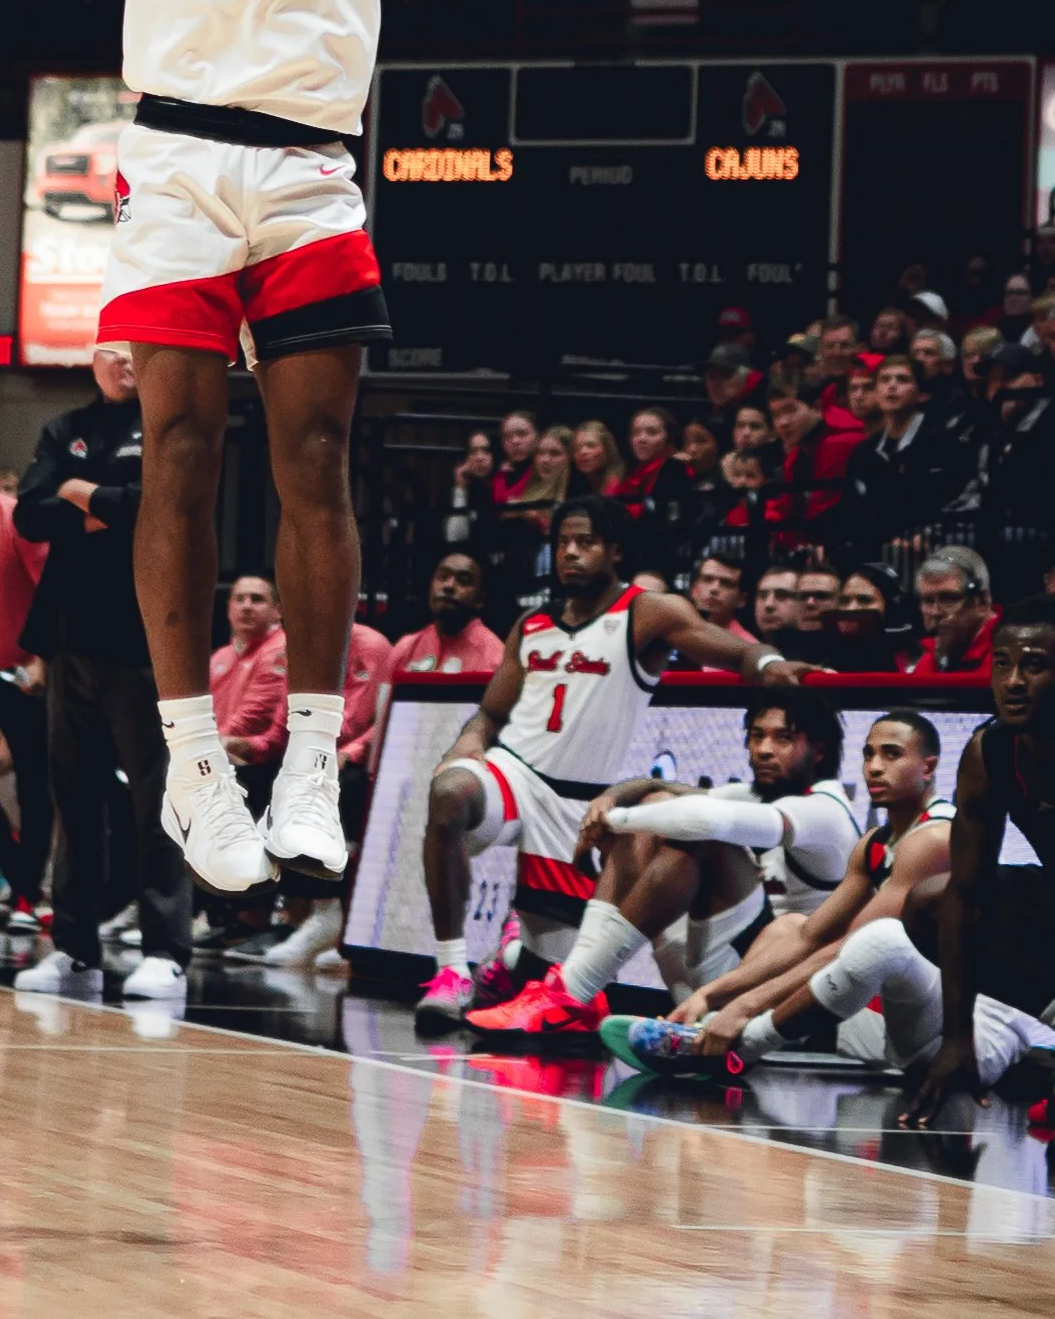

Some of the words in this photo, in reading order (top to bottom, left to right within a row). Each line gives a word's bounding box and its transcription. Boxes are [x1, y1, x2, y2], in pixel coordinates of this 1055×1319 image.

[382, 147, 514, 182] CARDINALS
[705, 145, 800, 181] CAJUNS
[539, 262, 606, 282] PLAYER
[613, 263, 656, 283] FOUL
[747, 263, 803, 283] FOUL
[527, 649, 563, 672] Ball
[547, 683, 567, 733] 1
